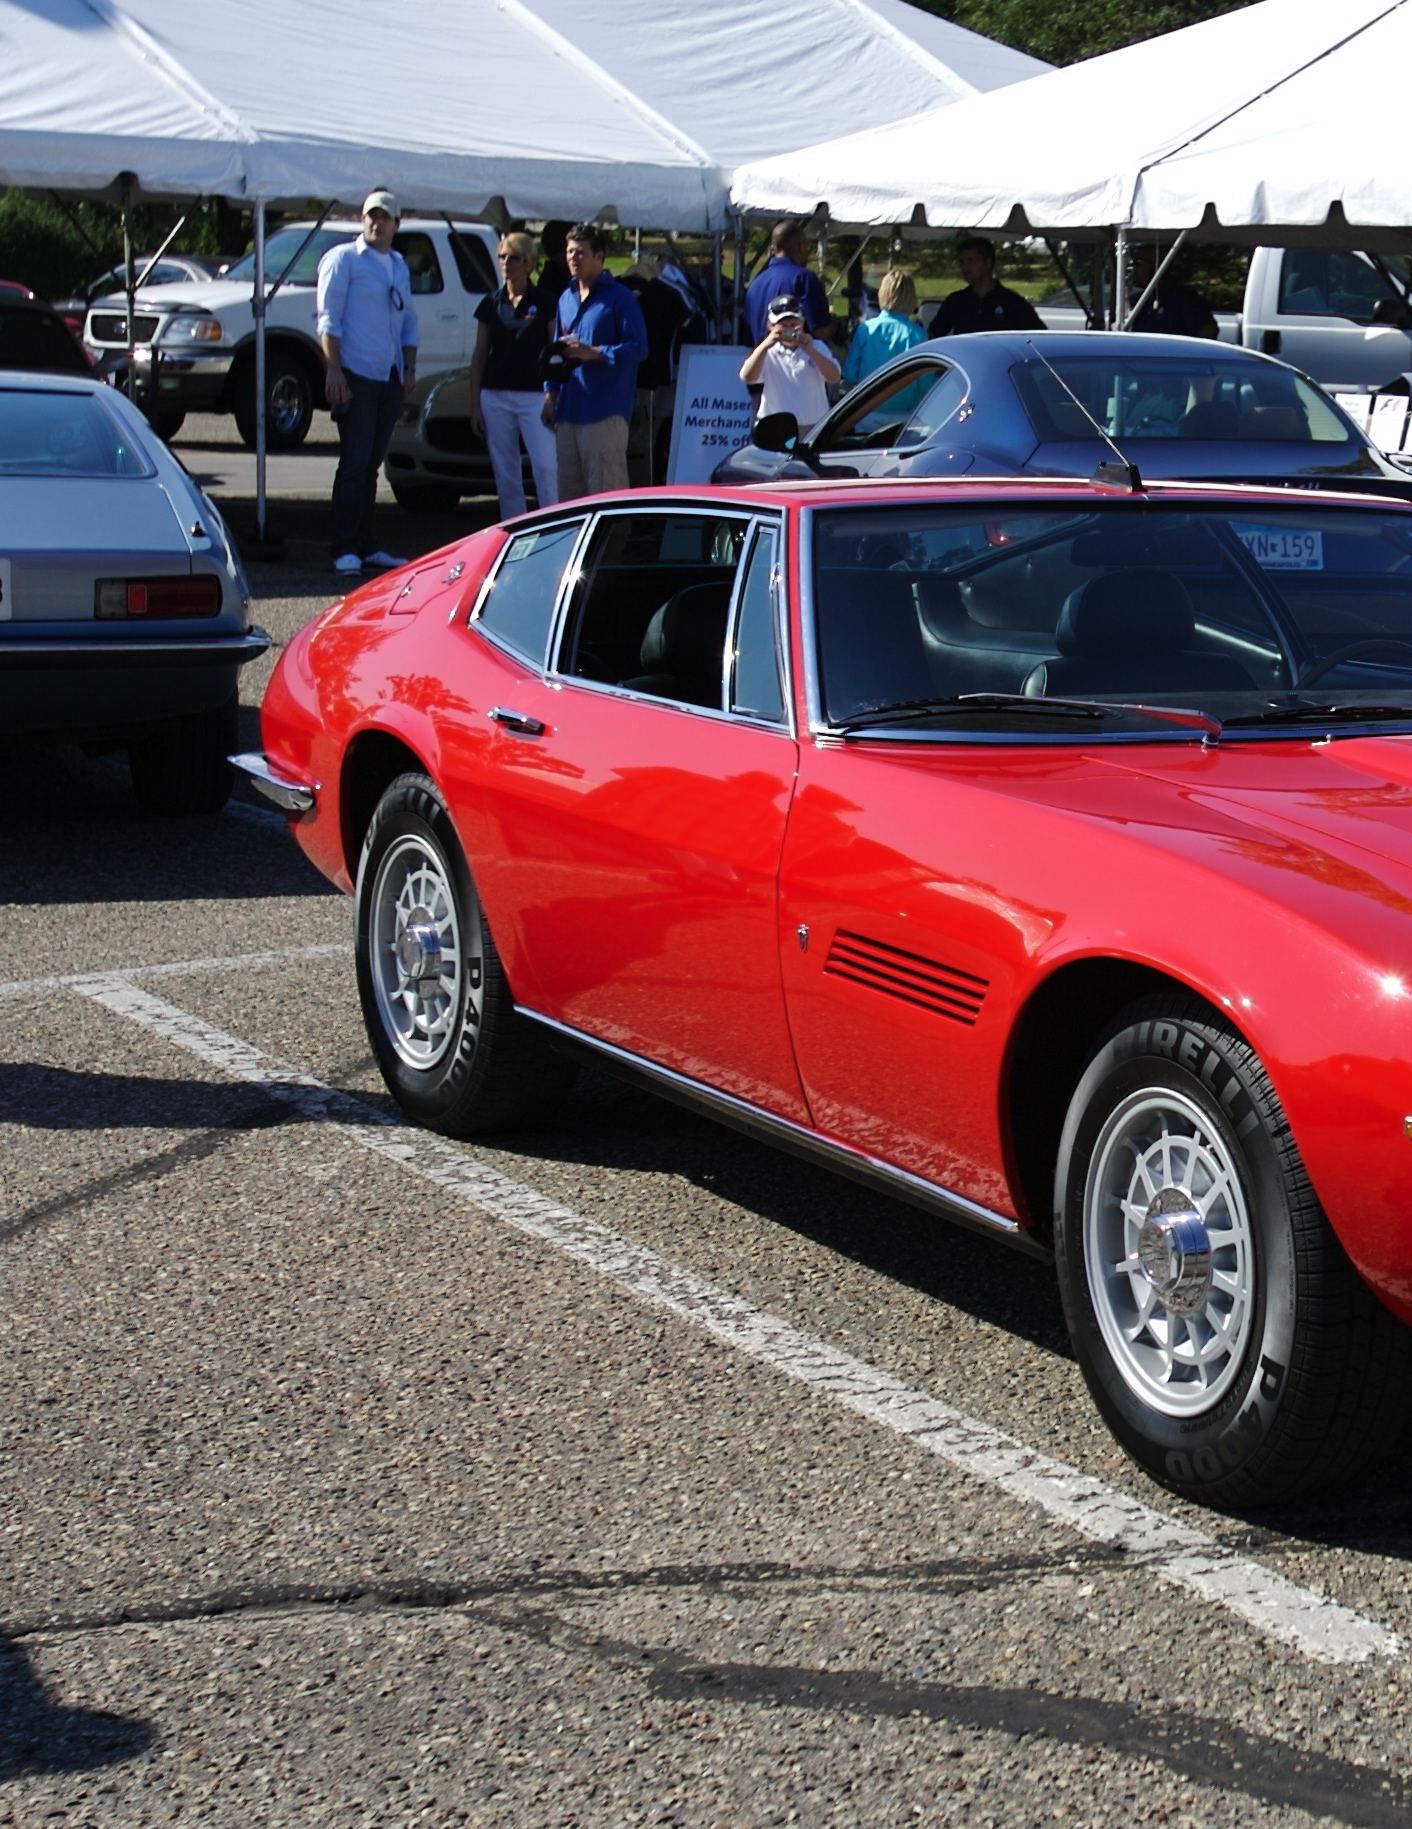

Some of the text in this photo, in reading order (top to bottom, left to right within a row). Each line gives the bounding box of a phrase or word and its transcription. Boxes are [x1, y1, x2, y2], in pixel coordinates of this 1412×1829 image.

[690, 397, 752, 411] All Maser
[684, 415, 751, 429] Merchand
[701, 434, 729, 447] 25%
[1280, 535, 1315, 558] 159
[1112, 1021, 1260, 1141] PIRELLI
[1164, 1353, 1287, 1484] P4000
